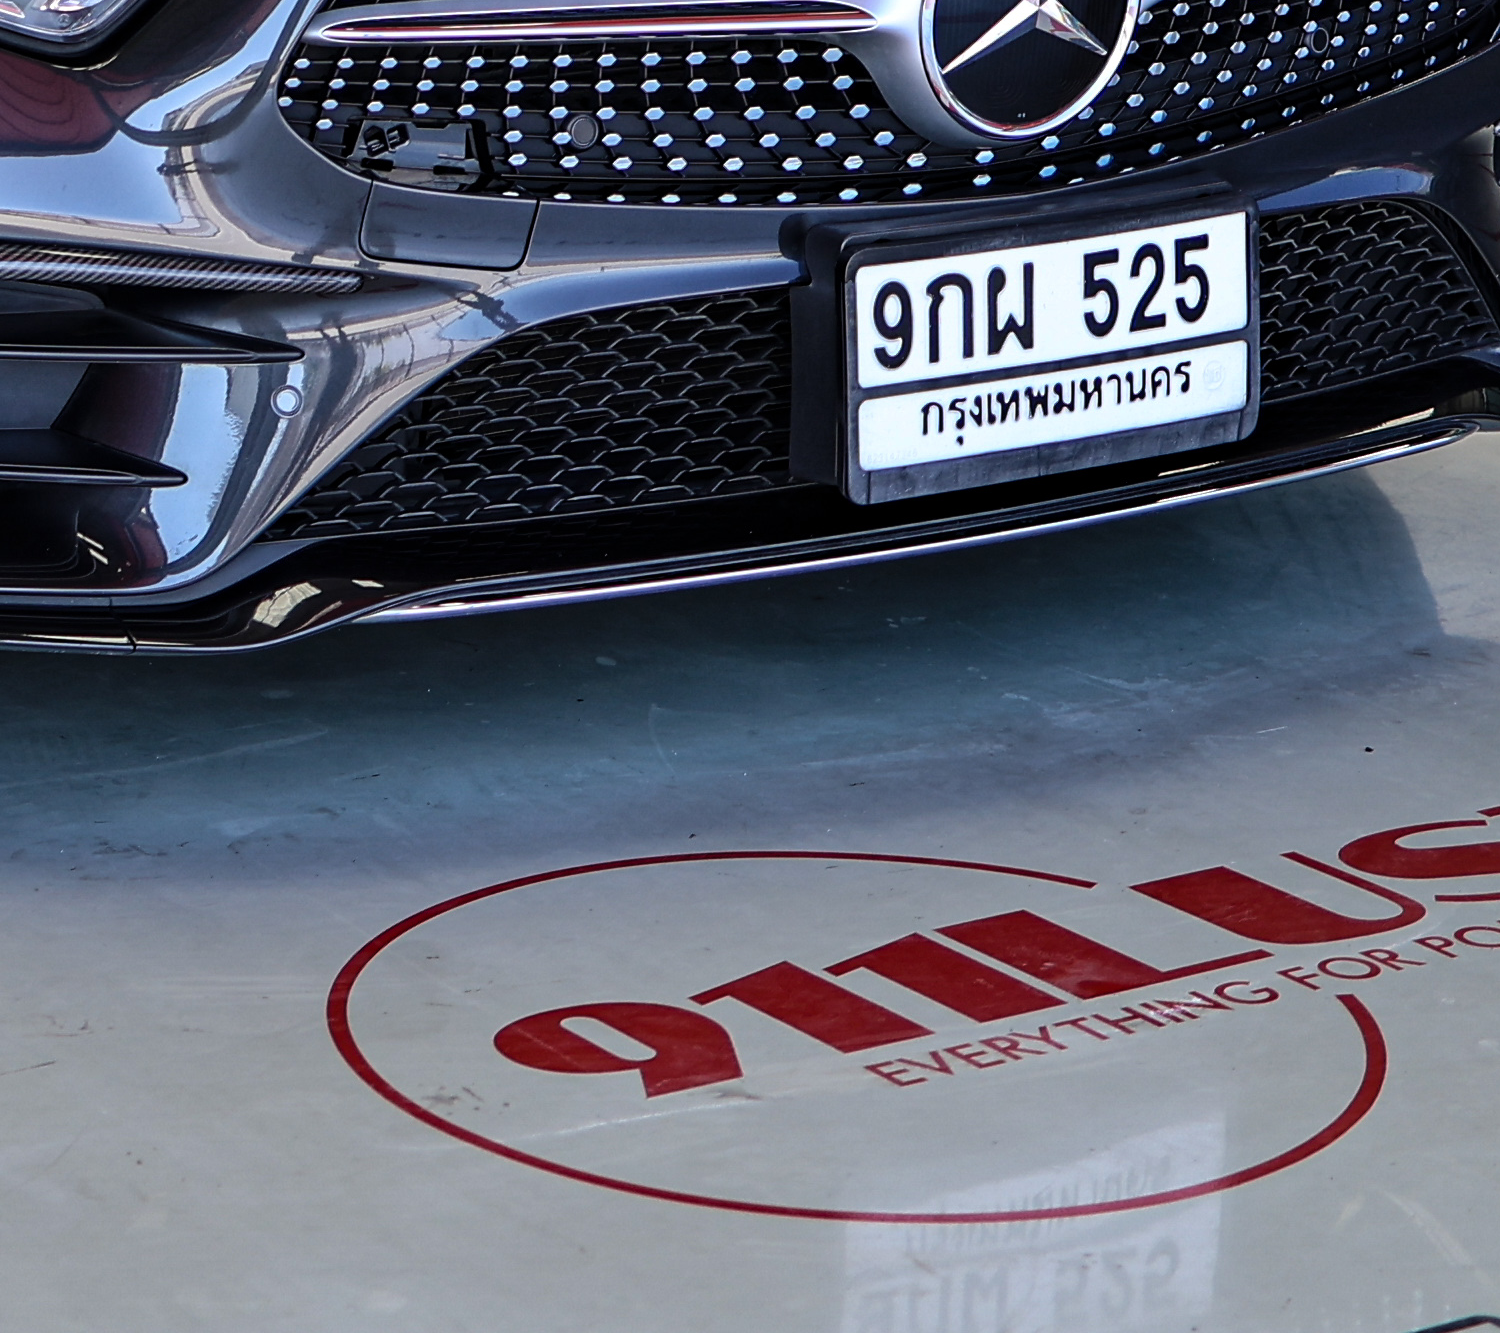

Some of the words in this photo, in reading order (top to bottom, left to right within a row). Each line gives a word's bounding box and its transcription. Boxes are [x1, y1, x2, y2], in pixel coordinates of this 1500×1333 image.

[1083, 233, 1210, 338] 525
[920, 360, 1192, 445] กรุงเทพมหานคร
[863, 978, 1281, 1088] EVERYTHING
[1277, 947, 1429, 992] FOR
